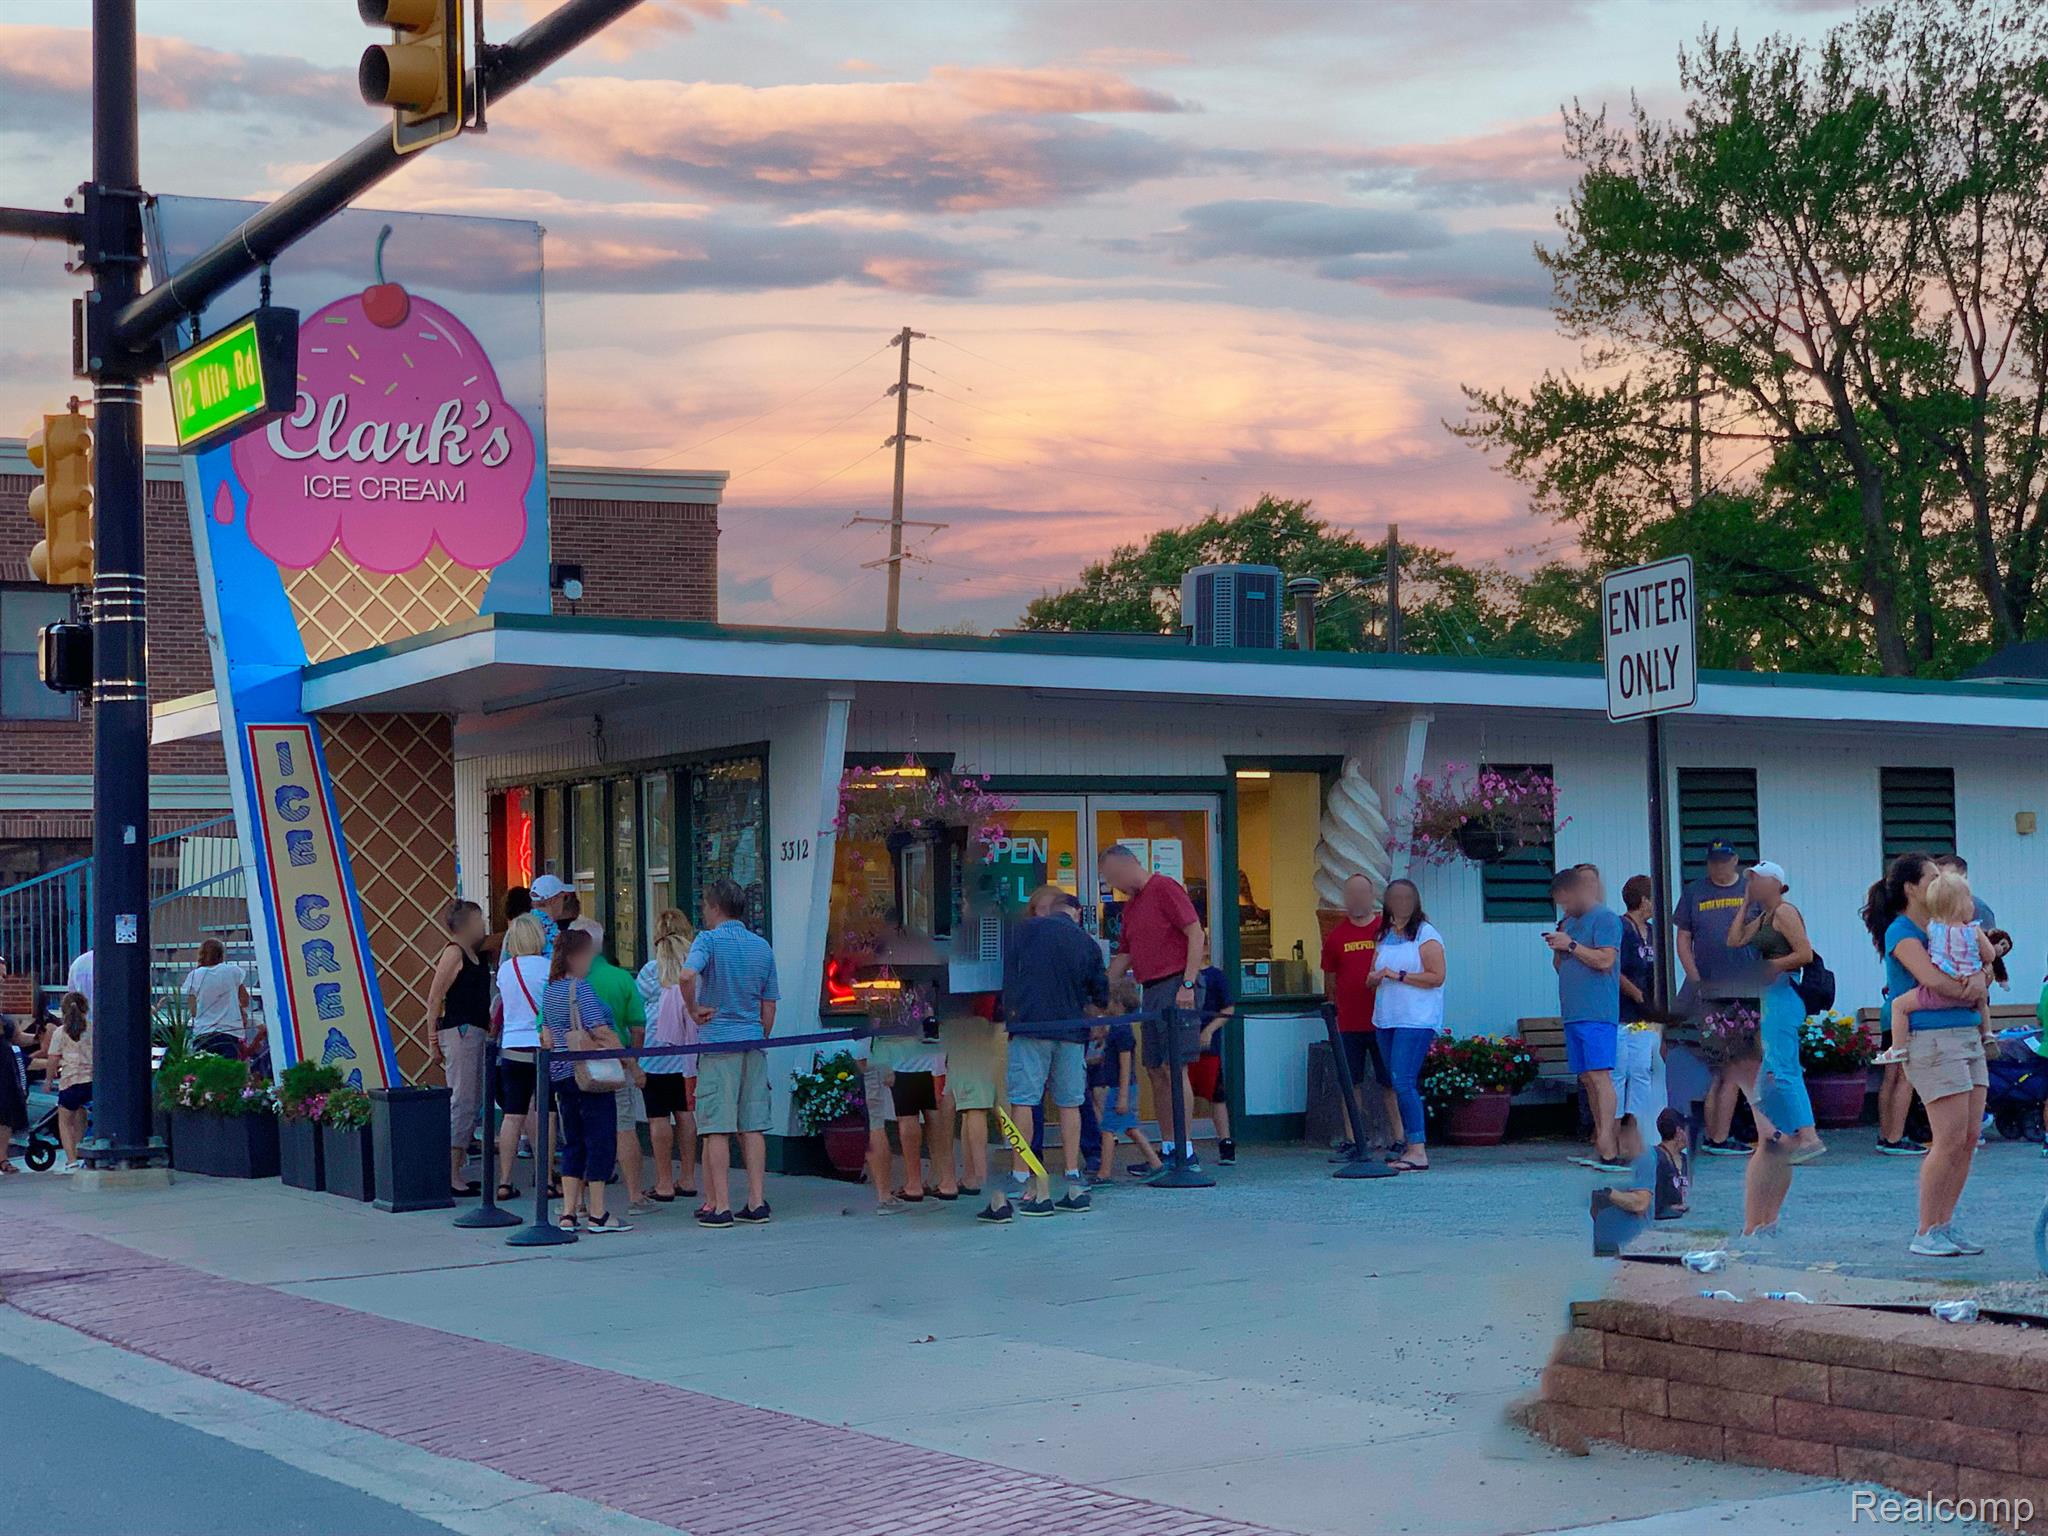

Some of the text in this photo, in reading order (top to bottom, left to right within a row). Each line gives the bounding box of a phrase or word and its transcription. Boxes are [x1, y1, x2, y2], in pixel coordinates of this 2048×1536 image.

[179, 343, 256, 420] 12 Mile Rd
[267, 391, 511, 467] Clark's
[304, 475, 465, 502] ICE CREAM
[1608, 576, 1688, 636] ENTER
[1619, 644, 1680, 699] ONLY
[274, 741, 317, 867] ICE
[781, 839, 809, 861] 3312
